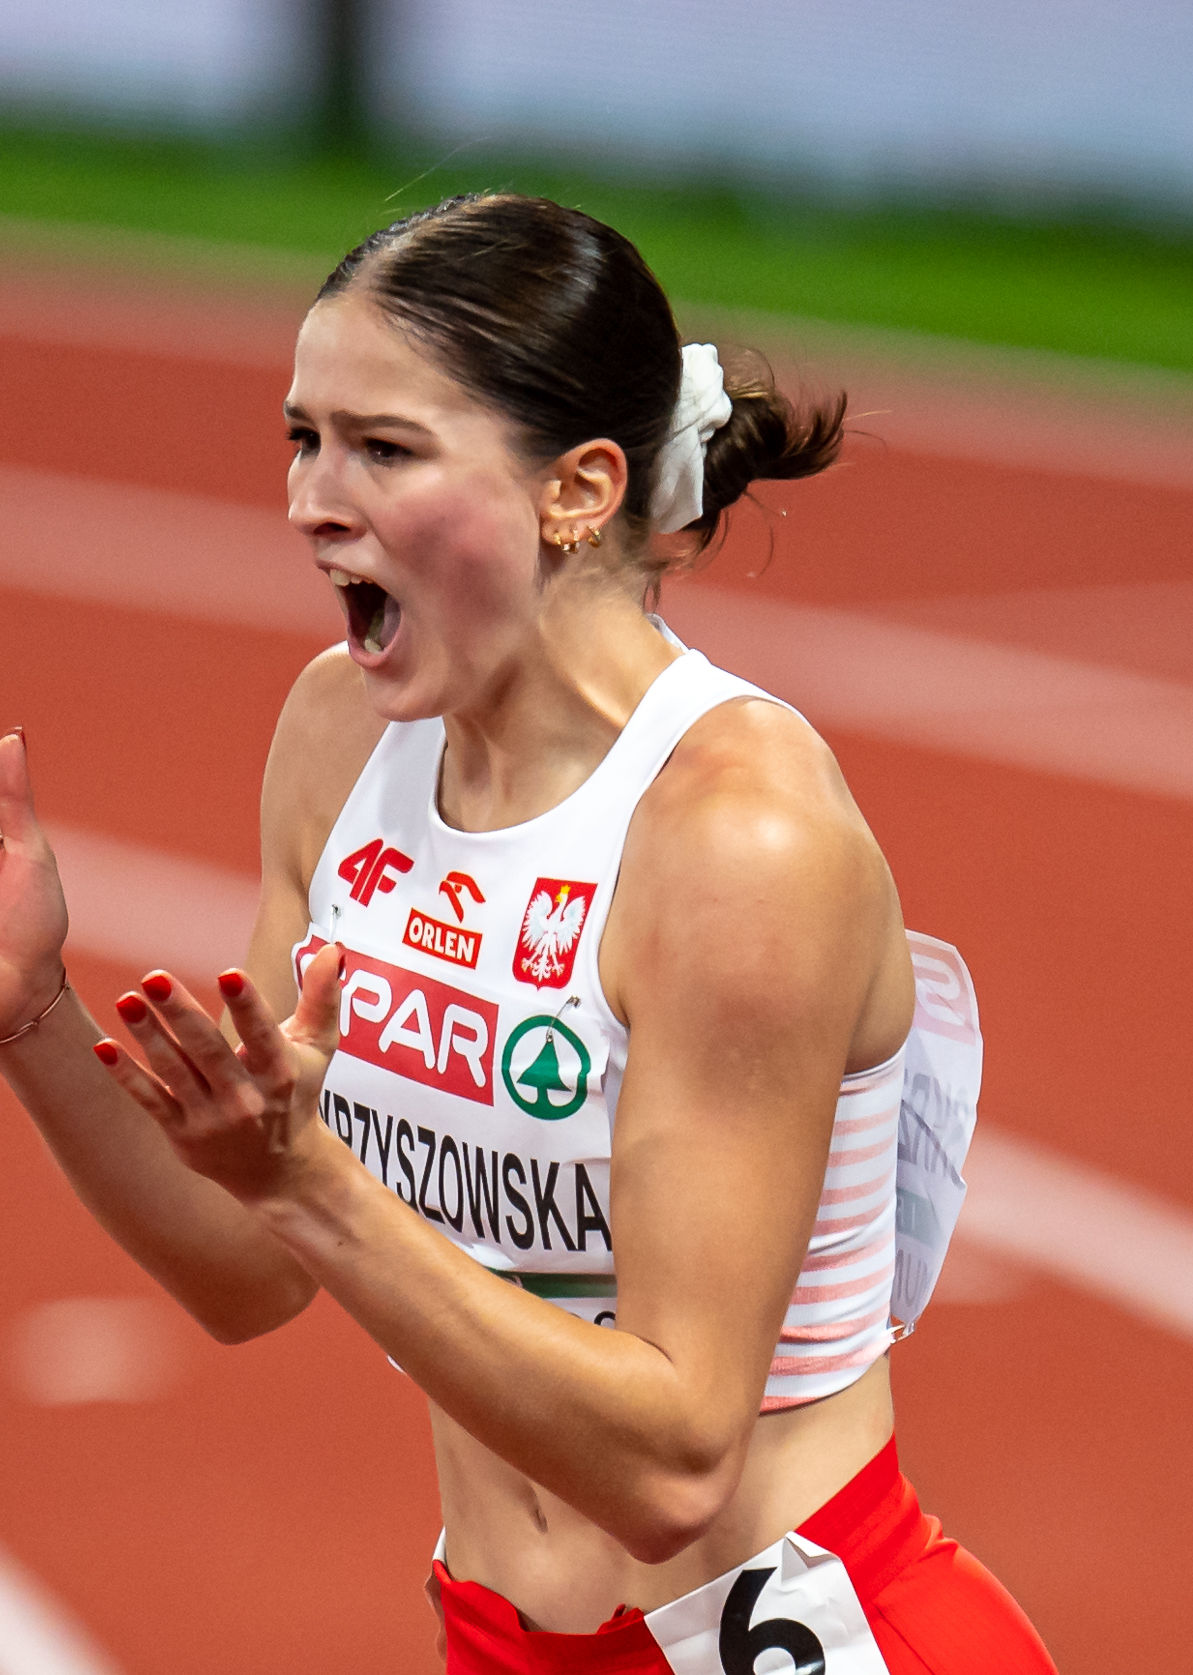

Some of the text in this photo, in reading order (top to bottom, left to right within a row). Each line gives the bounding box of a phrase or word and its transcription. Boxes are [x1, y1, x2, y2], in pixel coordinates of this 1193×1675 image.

[337, 838, 415, 907] 4F
[408, 916, 476, 963] ORLEN
[300, 953, 489, 1088] PAR
[319, 1088, 613, 1252] RZYSZOWSKA
[718, 1566, 826, 1675] 6
